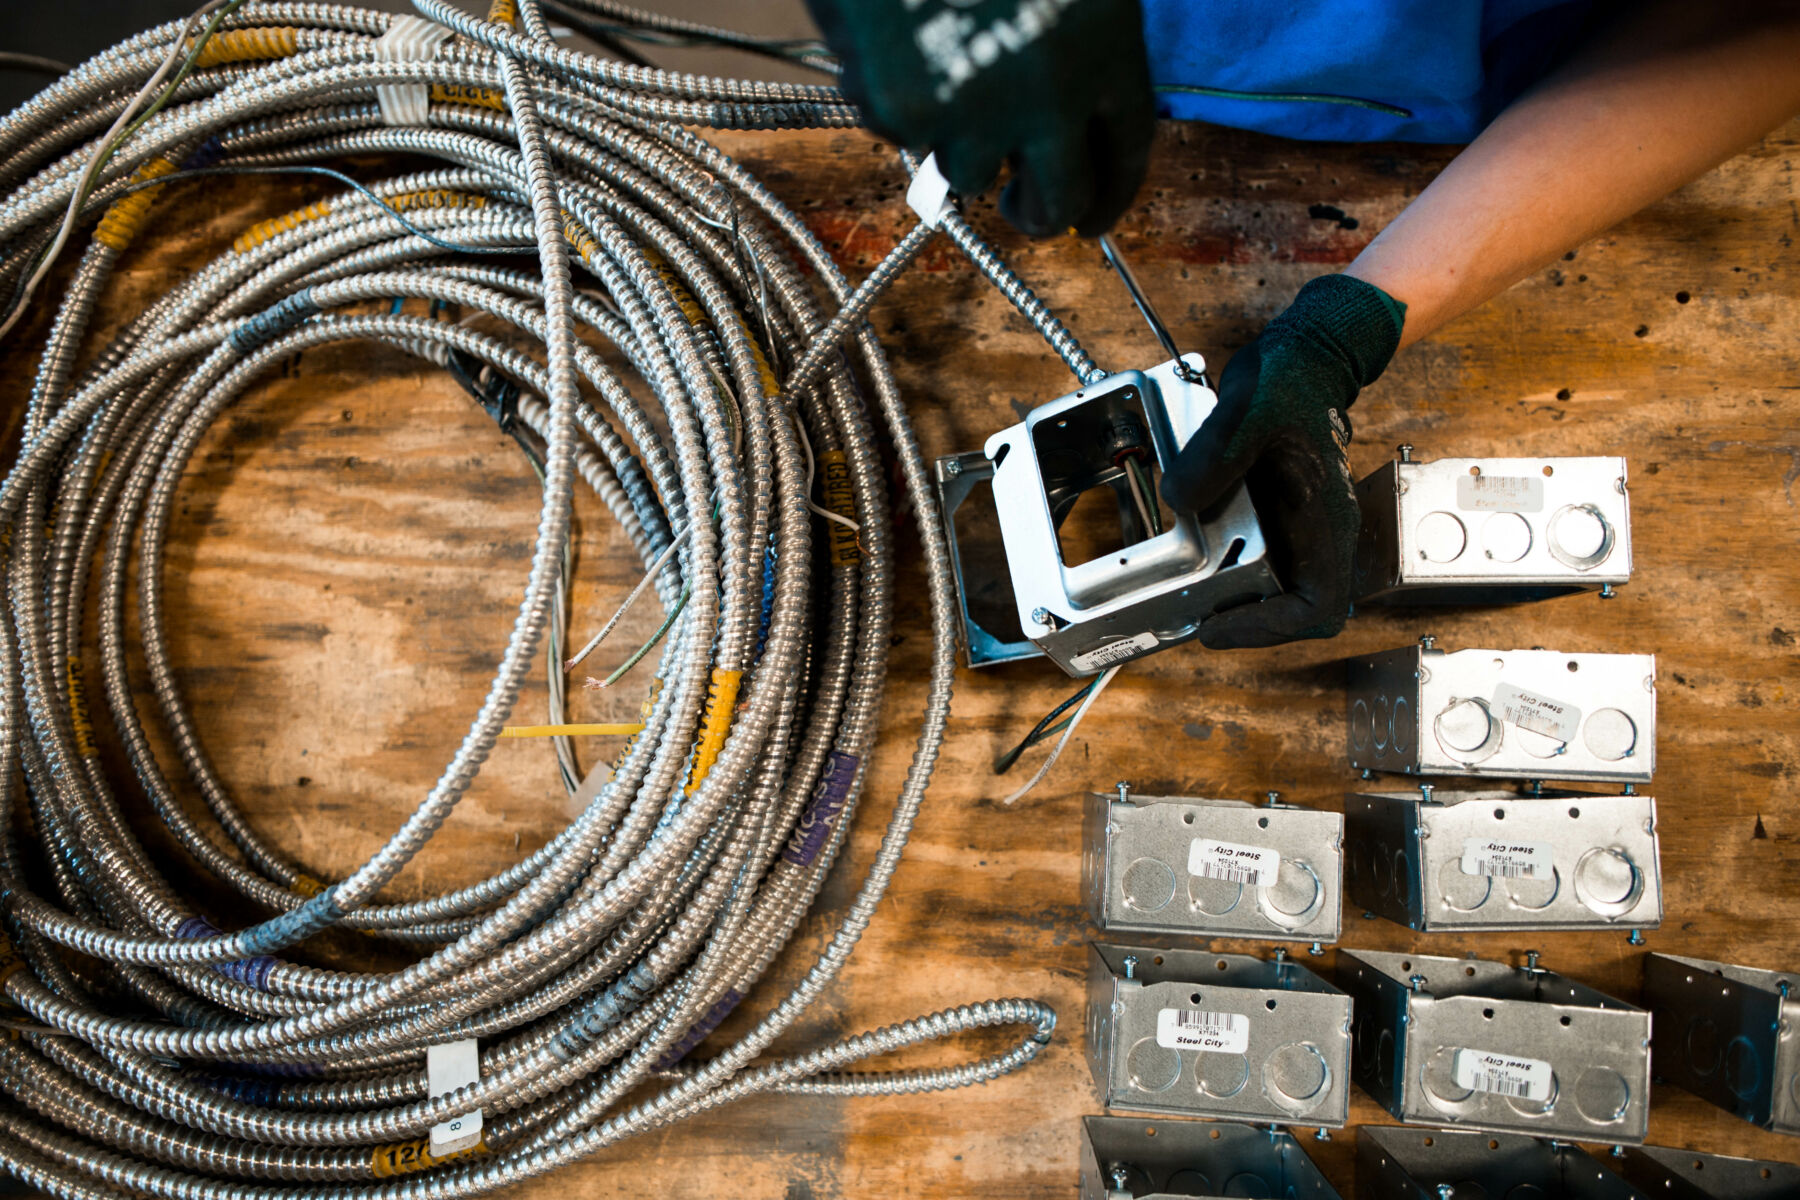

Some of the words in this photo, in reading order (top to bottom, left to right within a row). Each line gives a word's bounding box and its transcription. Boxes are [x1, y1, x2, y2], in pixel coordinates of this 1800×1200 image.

[1517, 693, 1537, 705] City
[1538, 701, 1564, 714] Steel
[1214, 846, 1233, 856] City
[1487, 843, 1506, 852] City
[1509, 846, 1534, 855] Steel
[1235, 851, 1261, 861] Steel
[1176, 1036, 1202, 1045] Steel
[1204, 1038, 1224, 1048] City
[1483, 1056, 1504, 1066] City
[1505, 1061, 1532, 1071] Steel
[385, 1143, 432, 1167] 12/
